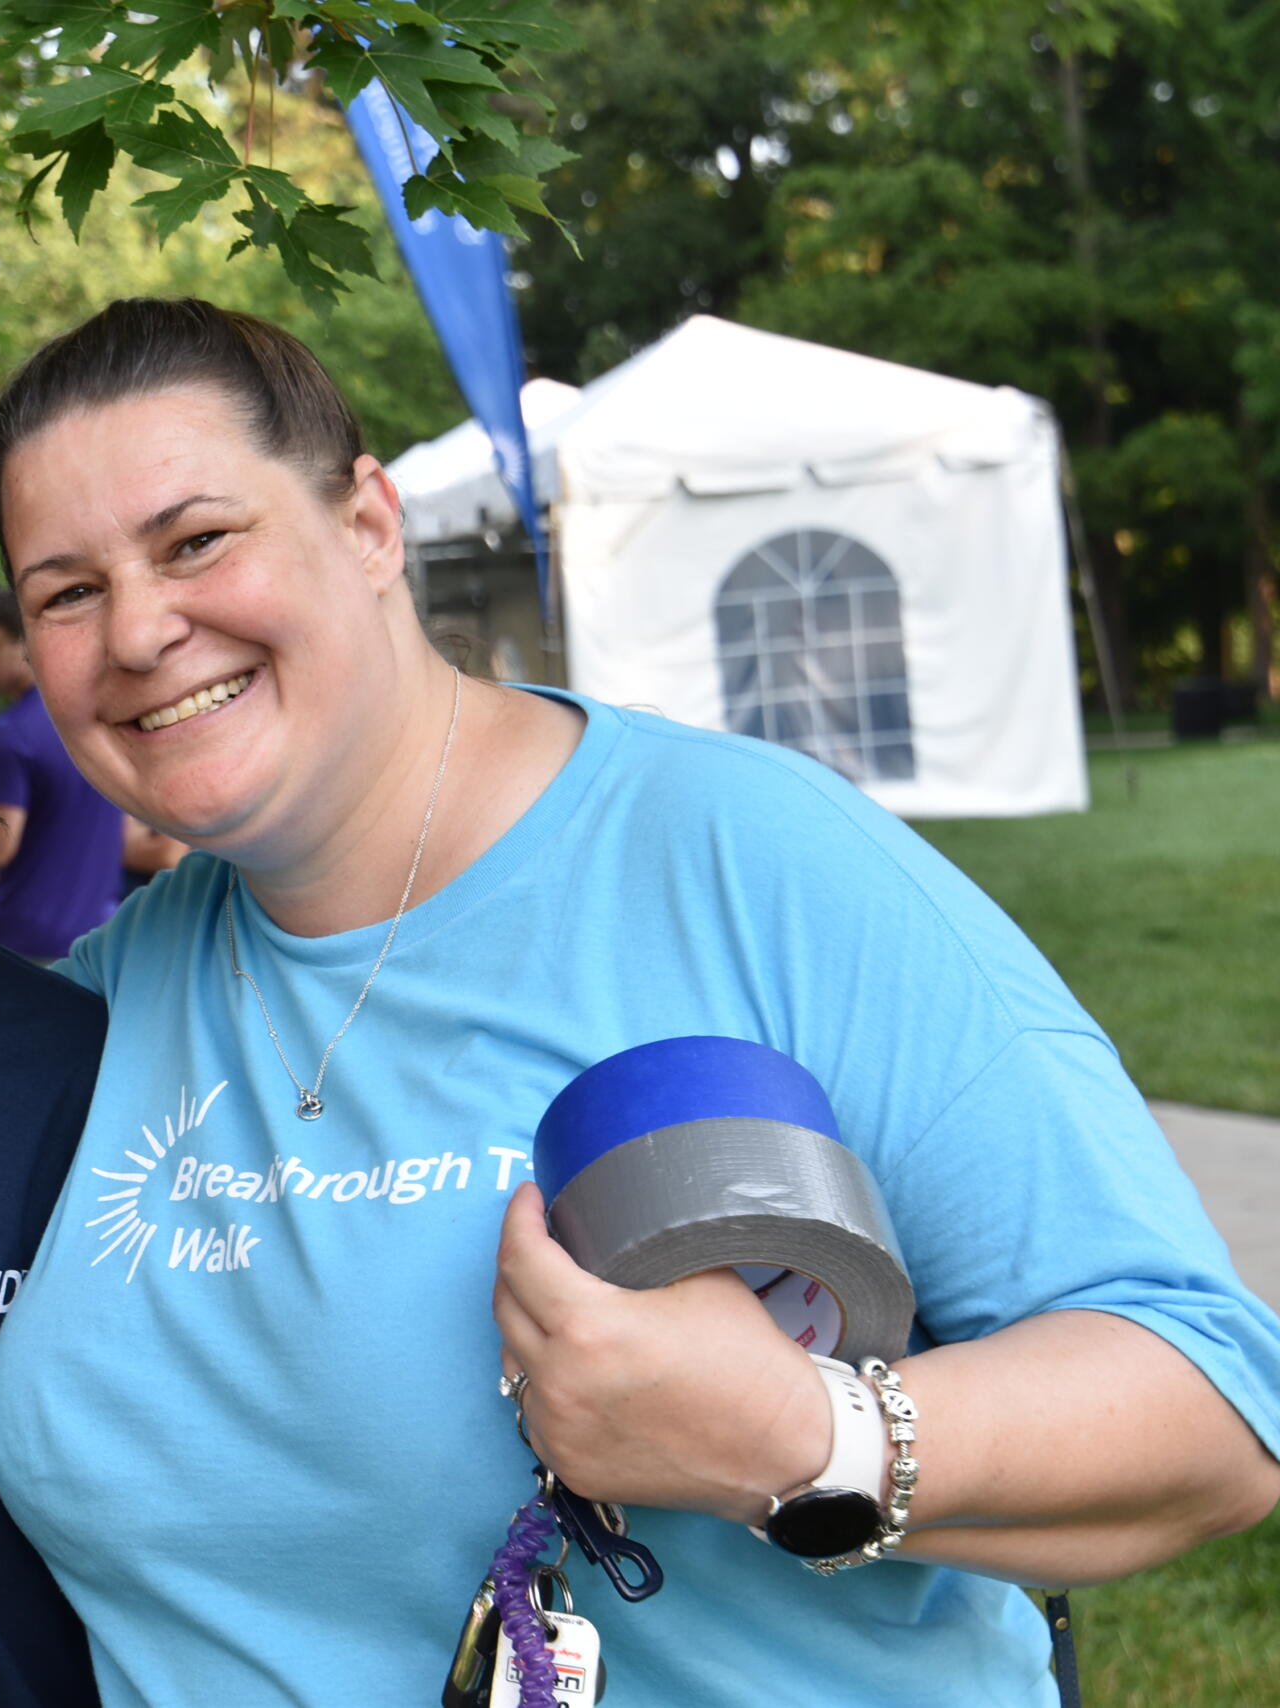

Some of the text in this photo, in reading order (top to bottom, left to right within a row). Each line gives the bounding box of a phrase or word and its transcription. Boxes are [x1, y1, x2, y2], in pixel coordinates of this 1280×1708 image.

[169, 1145, 534, 1206] Breakhrough T
[168, 1223, 262, 1273] Walk
